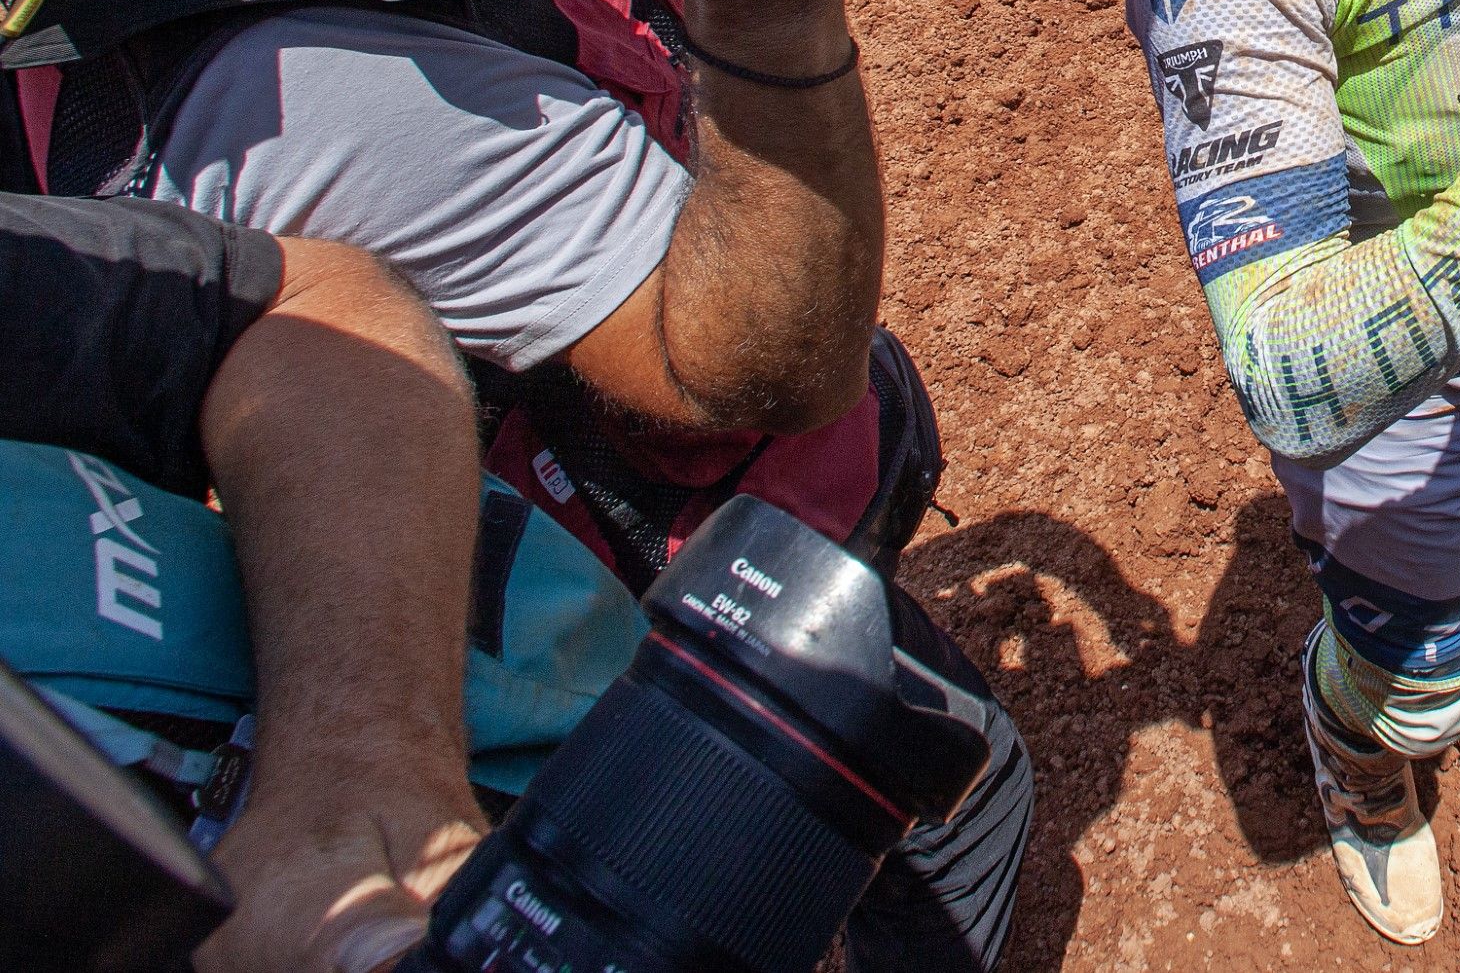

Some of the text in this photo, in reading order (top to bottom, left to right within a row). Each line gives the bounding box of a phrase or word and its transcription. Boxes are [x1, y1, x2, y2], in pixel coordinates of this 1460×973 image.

[1164, 46, 1209, 70] TRIUMPH
[1214, 155, 1264, 176] TEAM
[1192, 222, 1284, 271] RENTHAL
[730, 557, 784, 599] Canon
[711, 592, 752, 627] EW-82
[506, 881, 562, 935] Canon
